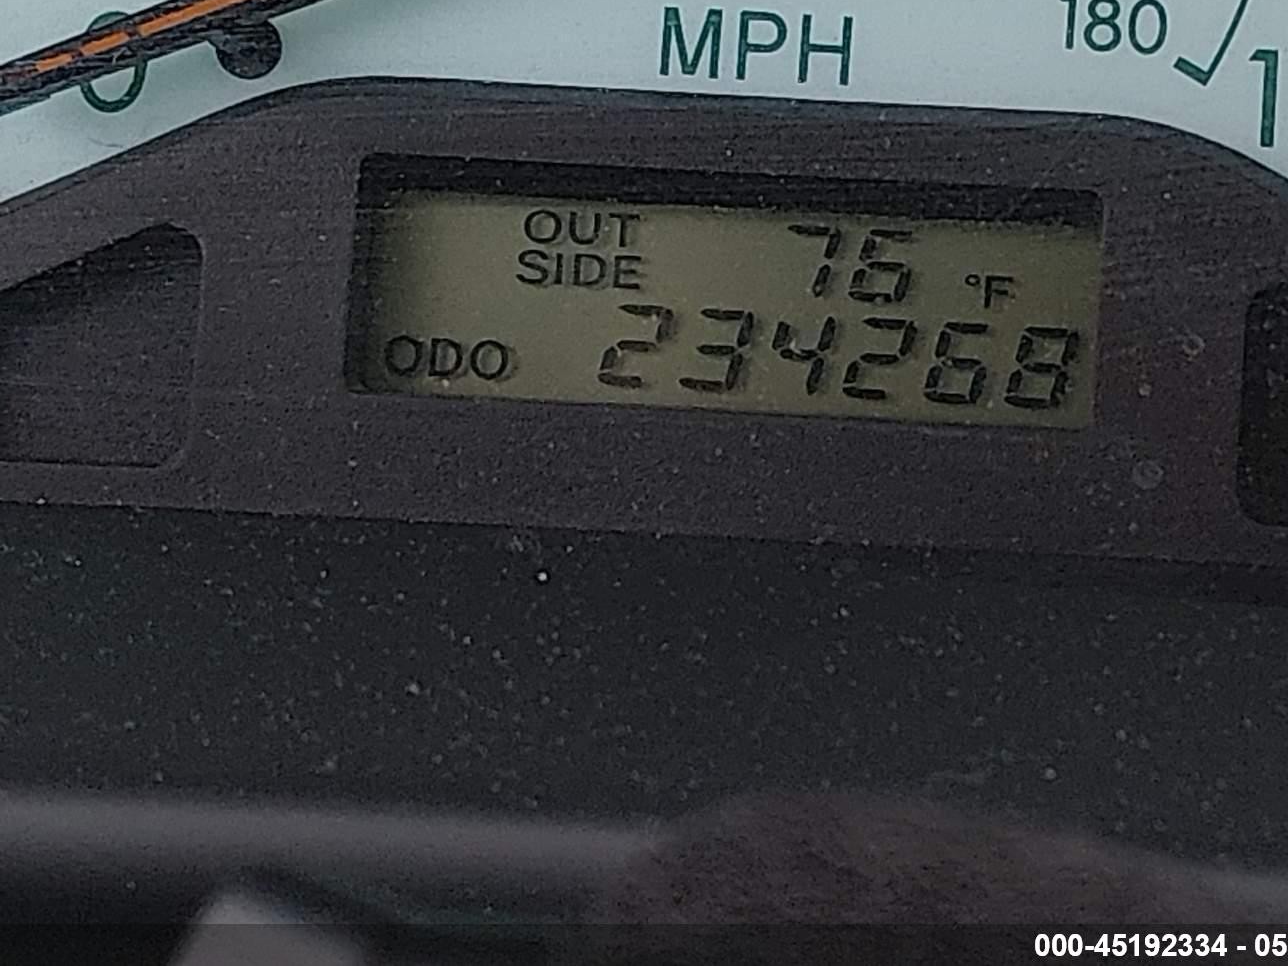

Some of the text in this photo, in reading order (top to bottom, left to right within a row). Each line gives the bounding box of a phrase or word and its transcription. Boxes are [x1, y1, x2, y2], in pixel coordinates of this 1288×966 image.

[660, 7, 853, 85] MPH
[524, 209, 642, 247] OUT
[516, 250, 642, 290] SIDE
[788, 224, 914, 303] 76
[384, 334, 511, 381] ODO
[598, 303, 1082, 409] 234268
